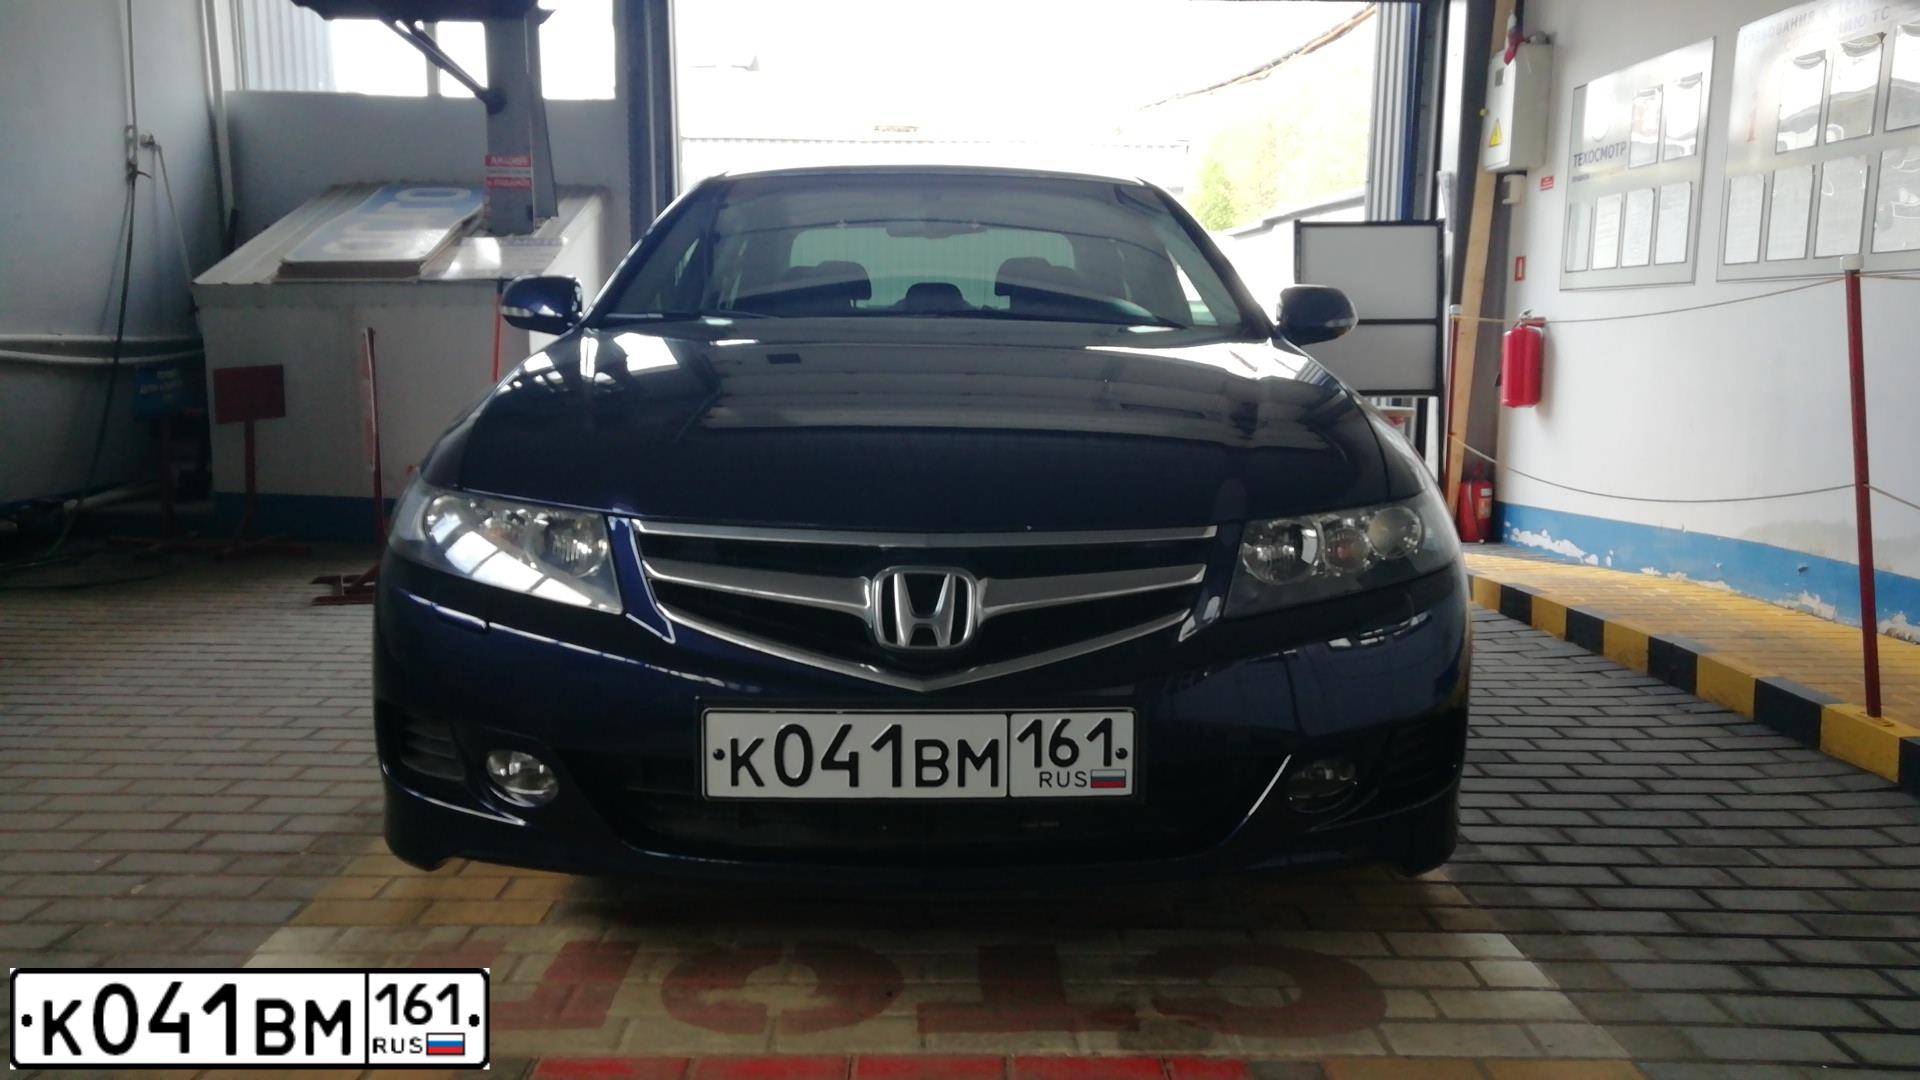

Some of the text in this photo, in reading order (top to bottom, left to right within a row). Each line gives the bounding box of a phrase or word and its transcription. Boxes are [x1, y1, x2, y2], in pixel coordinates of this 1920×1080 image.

[1573, 140, 1627, 168] ТЕХОСМОТР
[1016, 718, 1113, 768] 161
[1039, 771, 1088, 788] RUS
